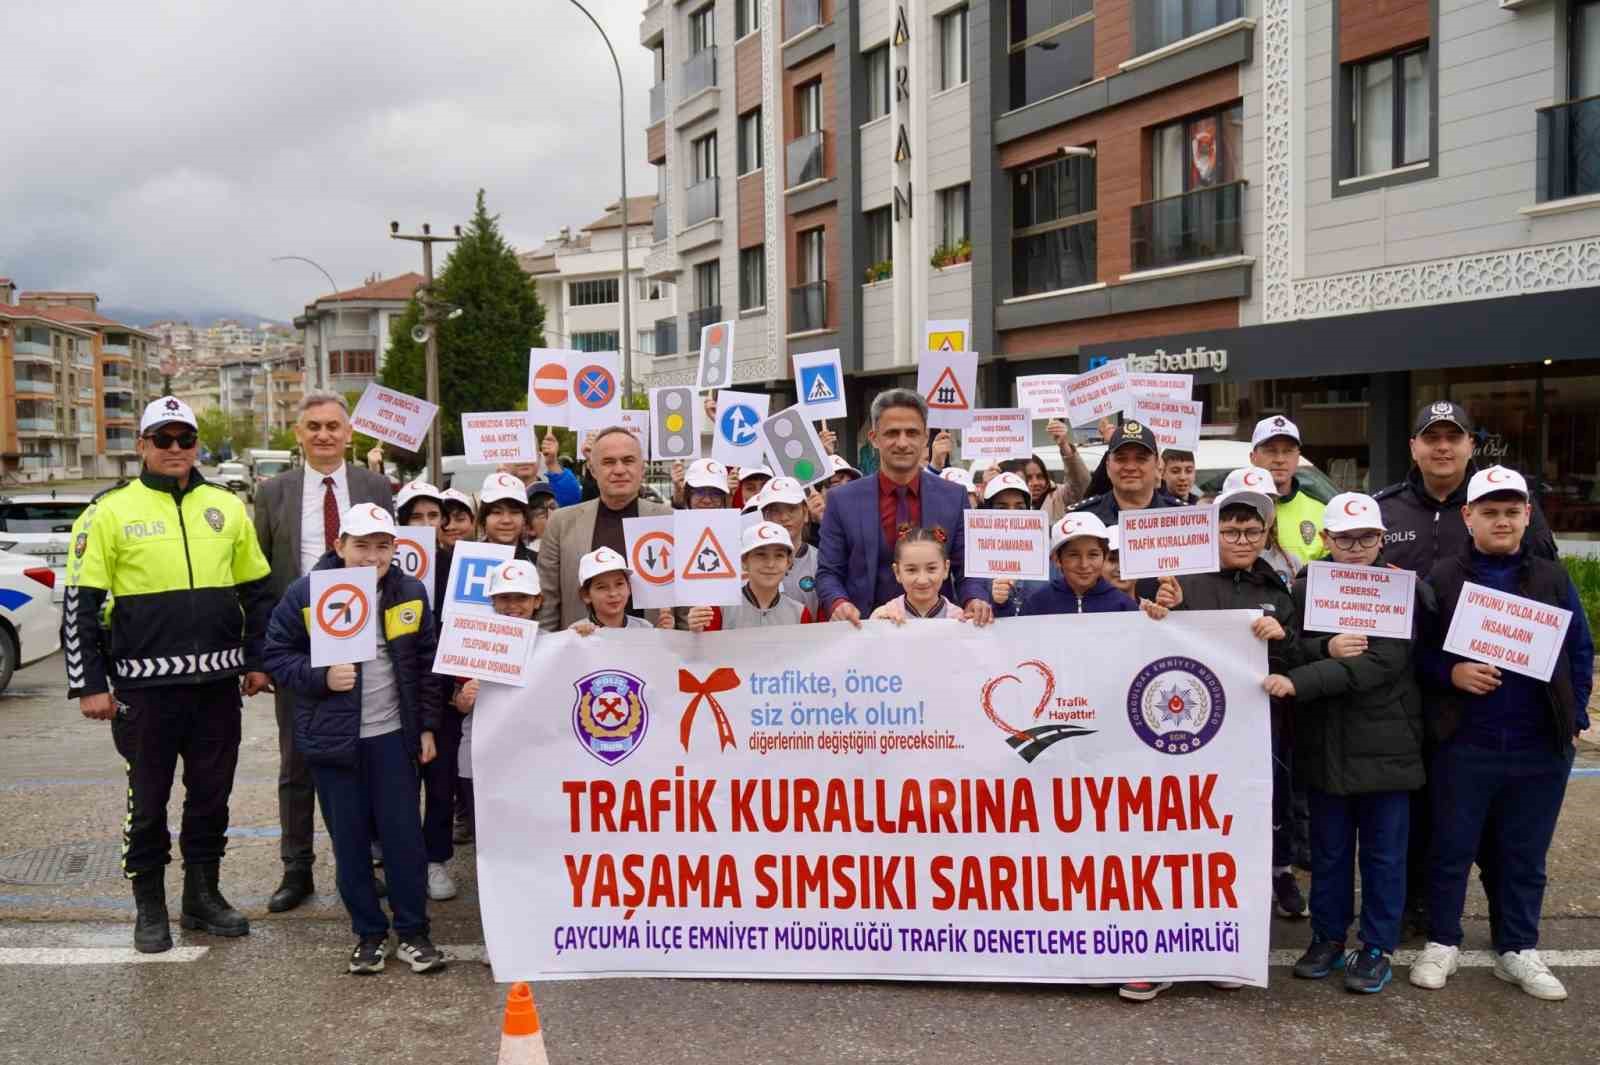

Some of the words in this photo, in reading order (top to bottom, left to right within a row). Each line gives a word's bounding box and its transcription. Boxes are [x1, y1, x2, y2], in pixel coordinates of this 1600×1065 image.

[893, 5, 912, 222] ARAN
[1157, 346, 1228, 373] bedding
[1126, 519, 1137, 531] NE
[1138, 517, 1159, 529] OLUR
[1128, 536, 1155, 551] TRAFİK
[1157, 532, 1210, 549] KURALLARINA
[1158, 556, 1180, 569] UYUN
[1330, 568, 1368, 581] ÇIKMAYIN
[1370, 573, 1390, 583] YOLA
[464, 563, 492, 598] H
[1314, 599, 1339, 610] YOKSA
[1375, 604, 1391, 616] ÇOK
[1394, 605, 1405, 616] MU
[1468, 591, 1504, 611] UYKUNU
[1506, 601, 1532, 619] YOLDA
[1470, 639, 1505, 659] KABUSU
[1505, 647, 1530, 667] OLMA
[749, 669, 837, 698] trafikte,
[845, 669, 903, 694] önce
[751, 703, 783, 727] siz
[790, 701, 858, 726] örnek
[865, 700, 925, 725] olun!
[1056, 697, 1088, 707] Trafik
[749, 731, 813, 755] diğerlerinin
[818, 730, 877, 754] değiştiğini
[880, 729, 965, 755] göreceksiniz...
[562, 765, 717, 833] TRAFİK
[730, 777, 1040, 834] KURALLARINA
[1052, 773, 1233, 836] UYMAK,
[564, 853, 742, 921] YAŞAMA
[754, 853, 917, 910] SIMSIKI
[930, 851, 1238, 912] SARILMAKTIR
[554, 925, 640, 956] ÇAYCUMA
[645, 920, 682, 955] İLÇE
[688, 921, 768, 950] EMNİYET
[775, 921, 893, 952] MÜDÜRLÜĞÜ
[899, 922, 967, 954] TRAFİK
[974, 927, 1087, 955] DENETLEME
[1093, 923, 1148, 955] BÜRO
[1155, 921, 1240, 954] AMİRLİĞİ
